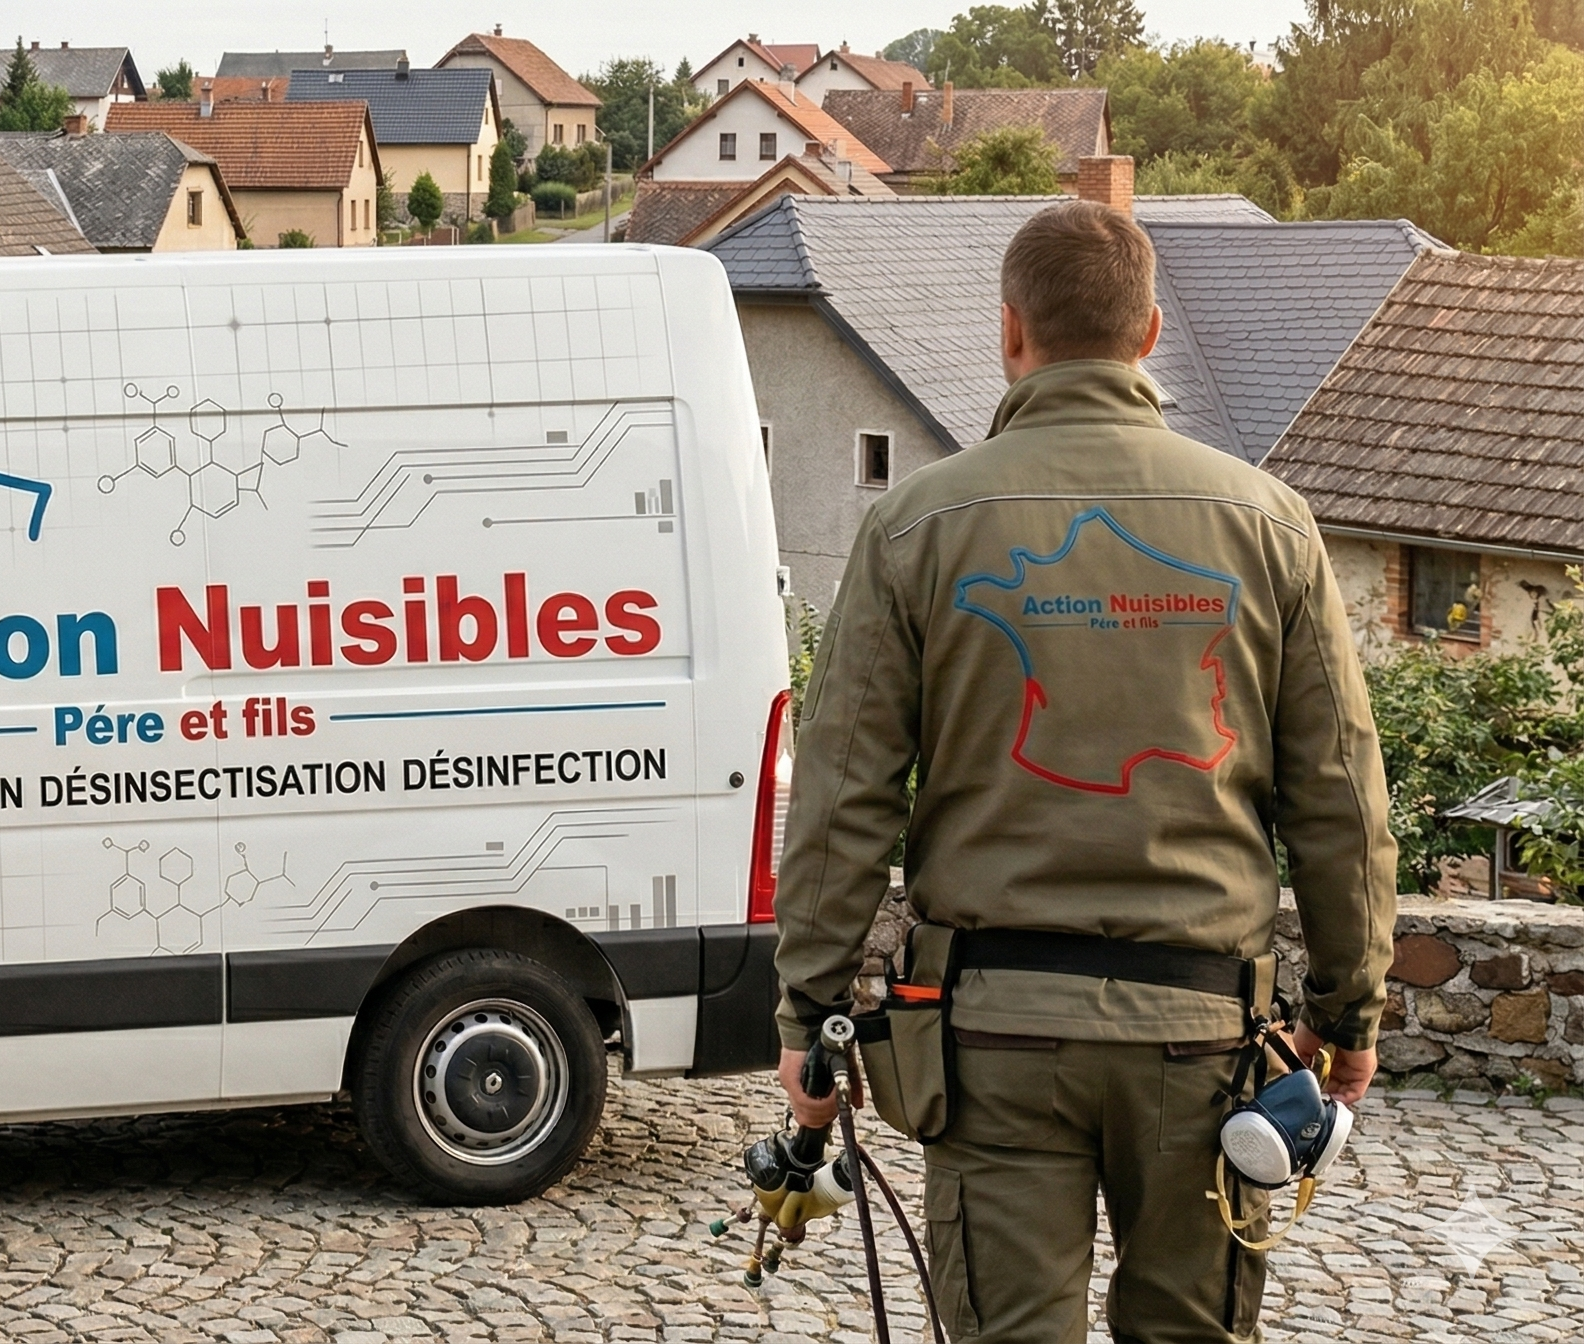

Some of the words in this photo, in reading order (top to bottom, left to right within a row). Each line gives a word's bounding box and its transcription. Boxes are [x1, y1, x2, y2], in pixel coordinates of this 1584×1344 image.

[156, 572, 663, 672] Nuisibles
[1022, 595, 1102, 615] Action
[1110, 594, 1225, 613] Nuisibles
[1140, 617, 1159, 629] fils
[54, 706, 164, 745] Pére
[179, 702, 228, 741] et
[241, 697, 316, 738] fils
[40, 760, 386, 808] DÉSINSECTISATION
[403, 747, 667, 791] DÉSINFECTION
